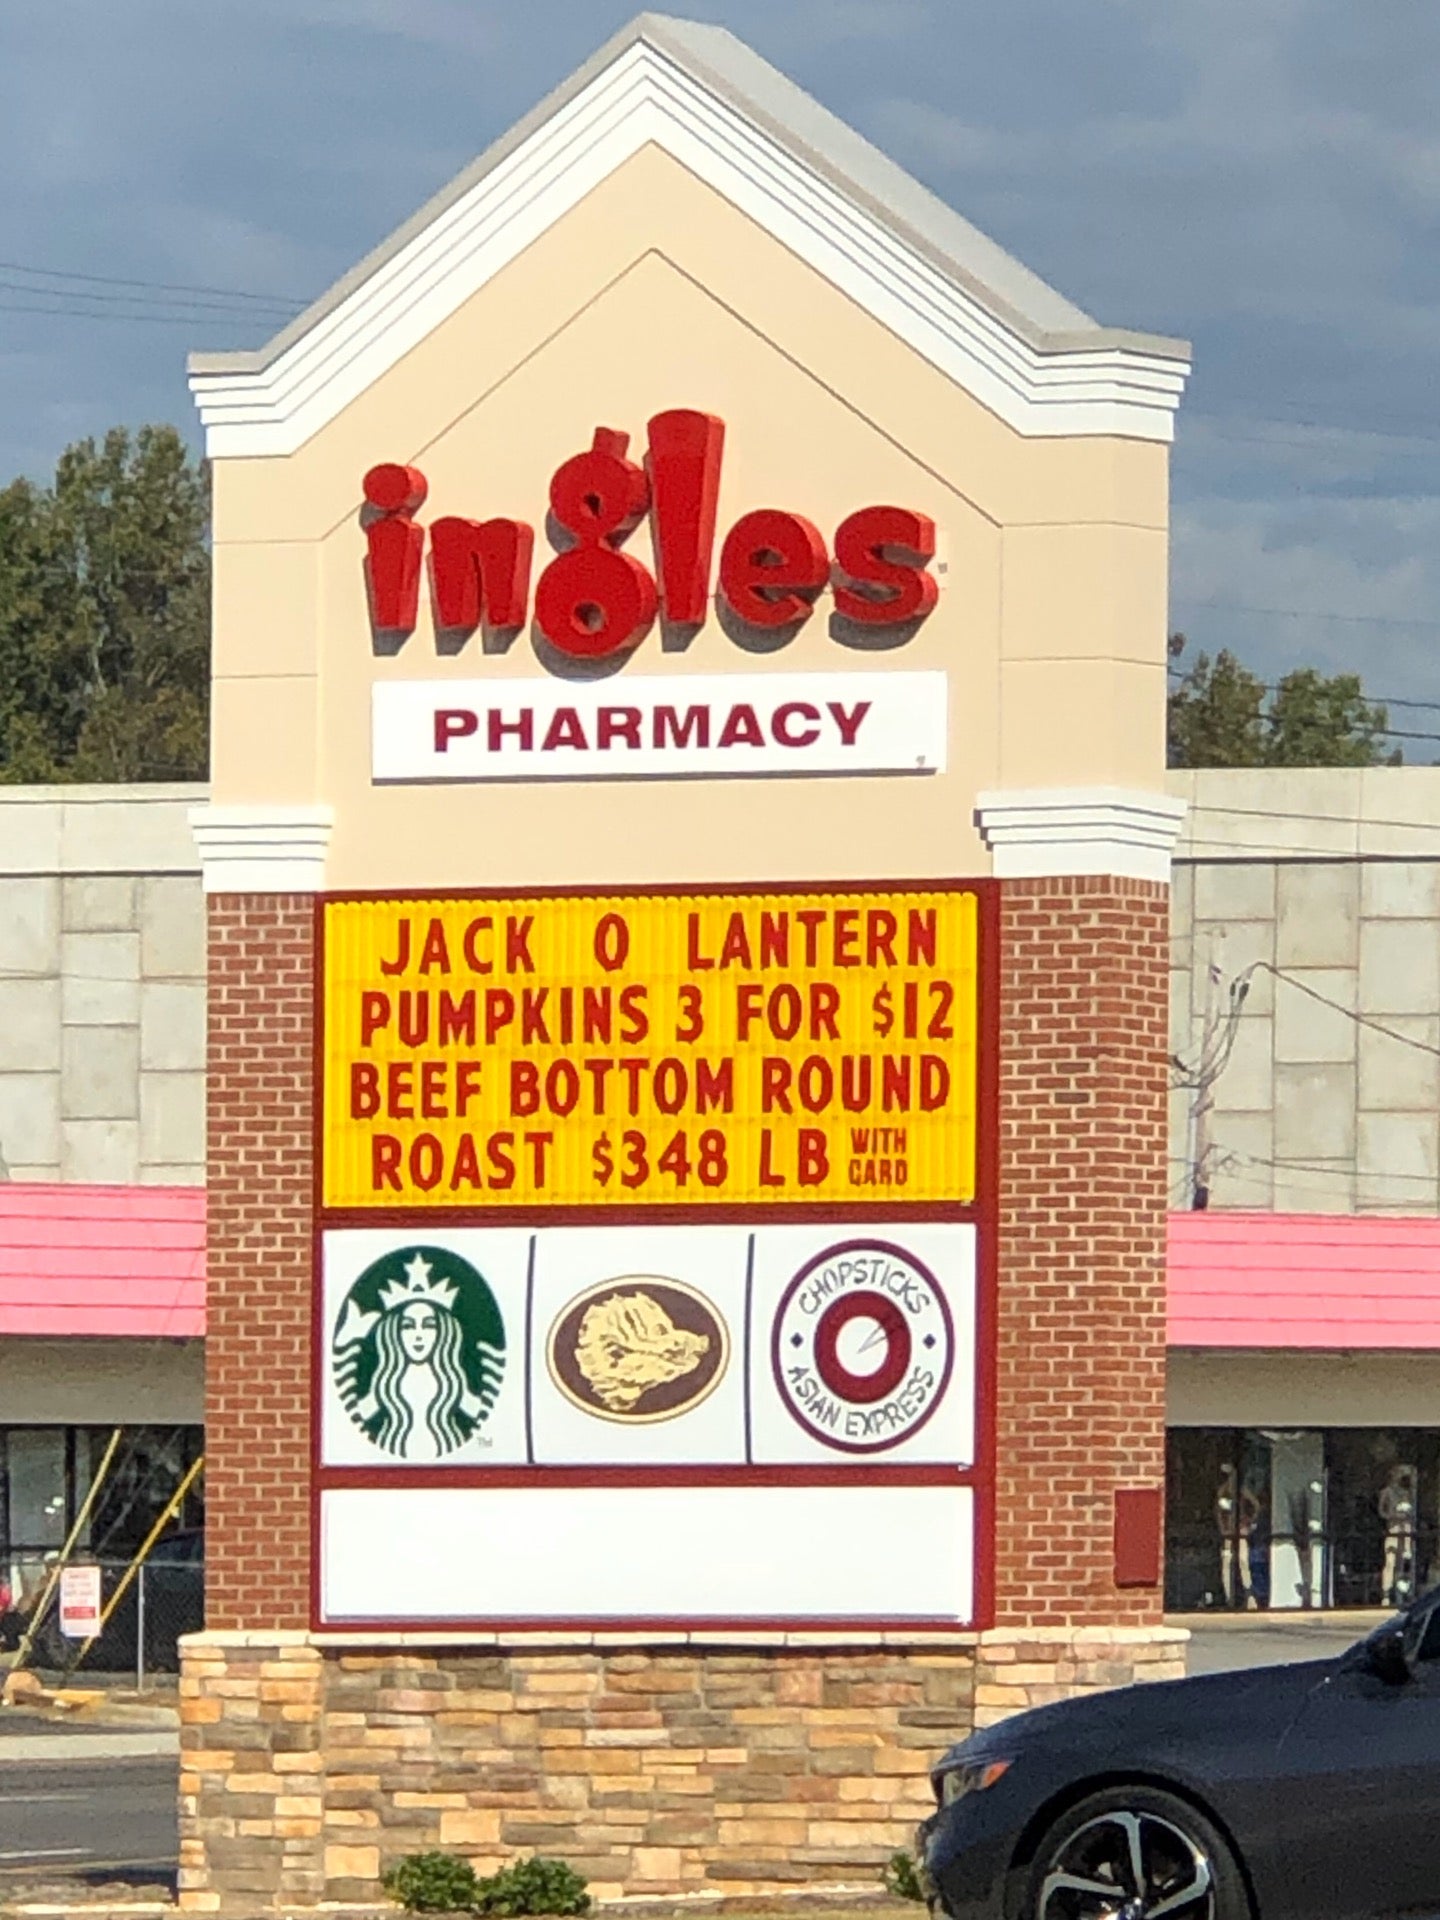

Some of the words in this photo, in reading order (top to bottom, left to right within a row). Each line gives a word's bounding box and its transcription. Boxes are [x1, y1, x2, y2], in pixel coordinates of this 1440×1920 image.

[362, 408, 940, 659] ingles
[433, 701, 872, 753] PHARMACY
[380, 915, 535, 975] JACK
[594, 912, 630, 971] O
[686, 908, 938, 971] LANTERN
[360, 984, 650, 1048] PUMPKINS
[675, 985, 705, 1043] 3
[736, 982, 842, 1042] FOR
[872, 980, 955, 1040] $12
[350, 1061, 483, 1119] BEEF
[511, 1057, 734, 1117] BOTTOM
[761, 1054, 950, 1114] ROUND
[371, 1131, 553, 1191] ROAST
[592, 1129, 728, 1189] $348
[760, 1127, 830, 1188] LB
[848, 1158, 908, 1186] CARD
[850, 1127, 907, 1154] WITH
[799, 1259, 930, 1314] CHOPSTICKS
[788, 1366, 842, 1428] ASIAN
[845, 1366, 934, 1436] EXPRESS
